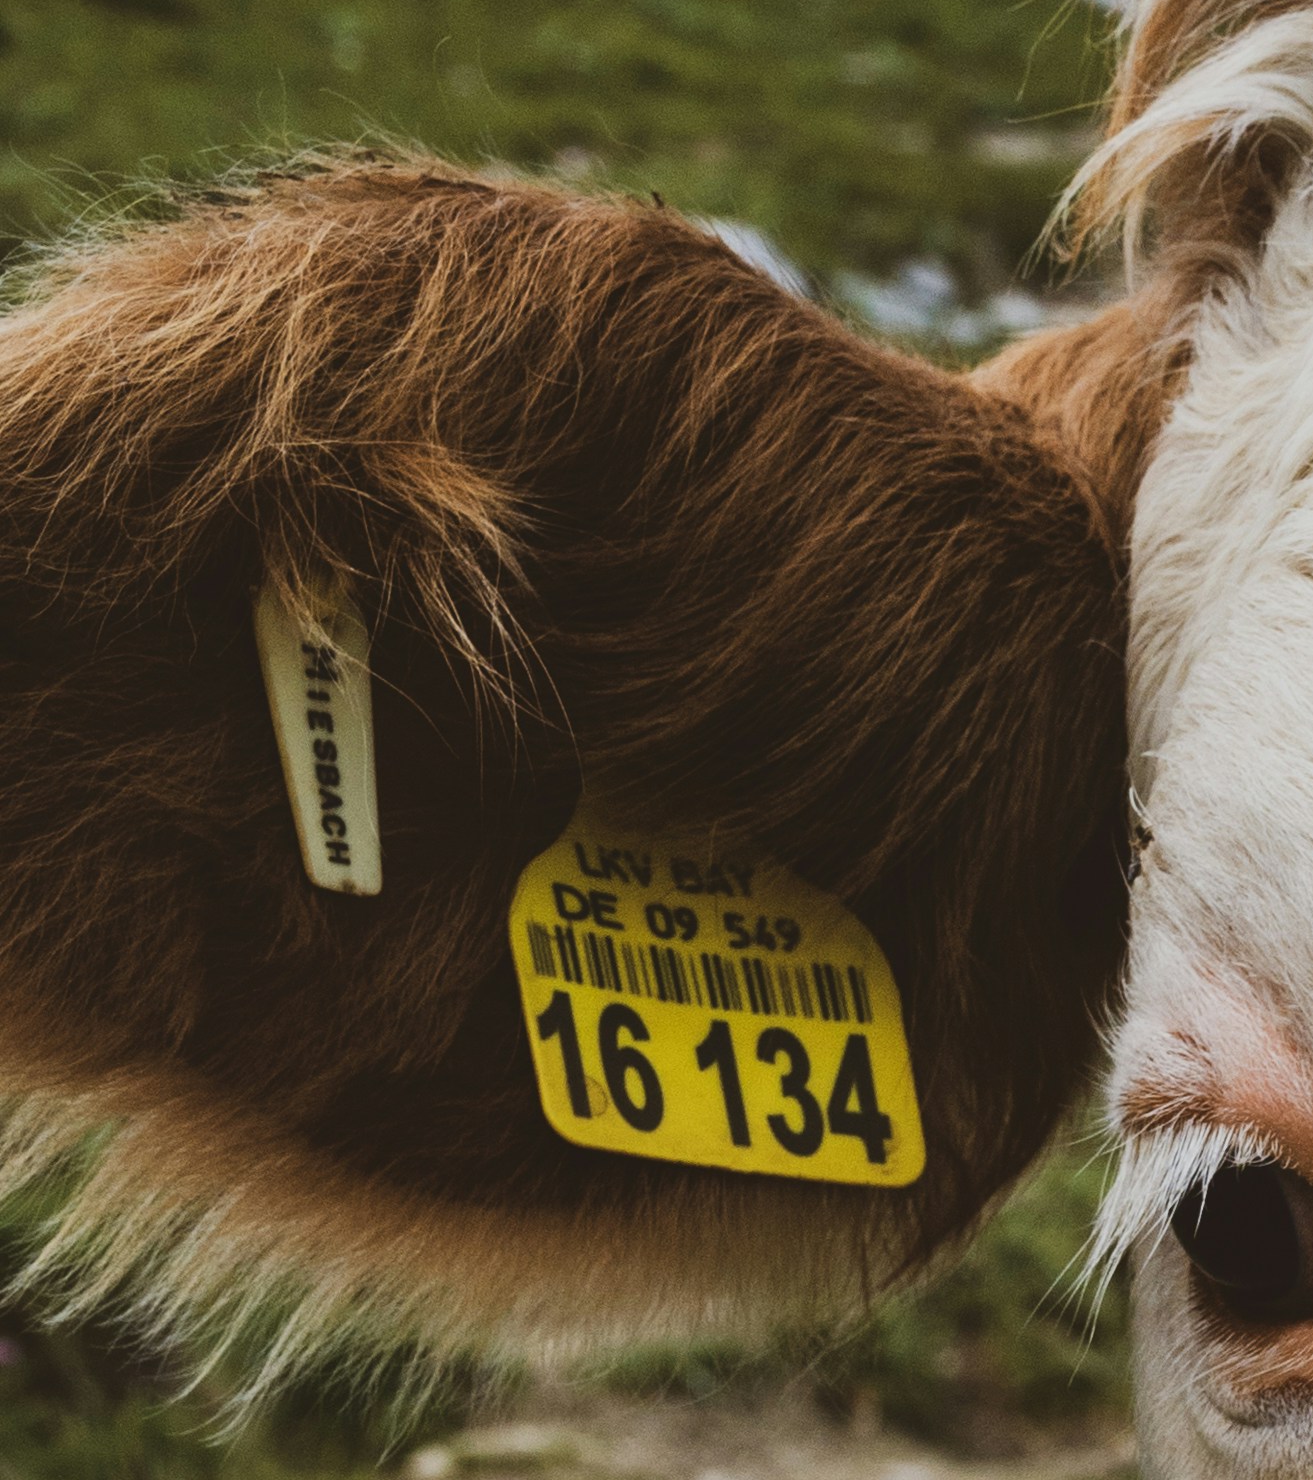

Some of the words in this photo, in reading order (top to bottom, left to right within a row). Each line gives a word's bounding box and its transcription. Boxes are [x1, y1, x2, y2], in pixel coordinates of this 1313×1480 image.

[573, 841, 653, 889] LKV
[551, 881, 626, 932] DE
[644, 902, 699, 942] 09
[722, 911, 802, 953] 549
[535, 988, 665, 1134] 16
[695, 1019, 895, 1165] 134
